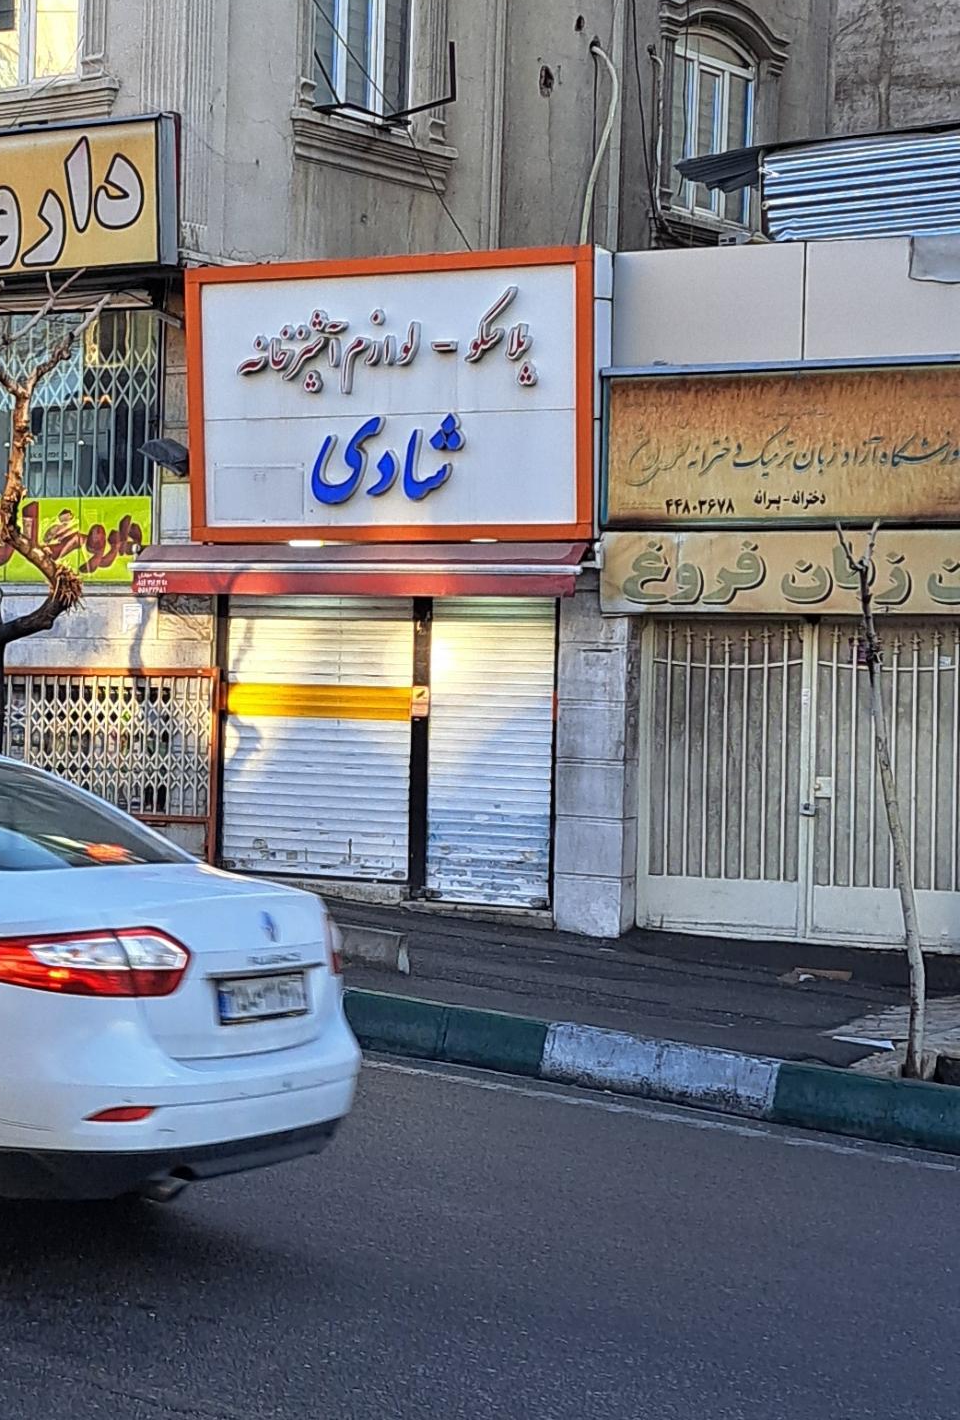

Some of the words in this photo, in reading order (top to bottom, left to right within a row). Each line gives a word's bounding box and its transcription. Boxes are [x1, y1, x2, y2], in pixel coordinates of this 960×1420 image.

[237, 309, 349, 393] آشپزخانه
[341, 309, 421, 394] لوازم
[464, 286, 537, 386] پلاسکو
[311, 412, 466, 505] شادی
[793, 441, 839, 474] زبان
[841, 435, 883, 468] آزاد
[665, 498, 735, 516] ۴۴۸۰۳۶۷۸
[622, 540, 766, 605] فروغ
